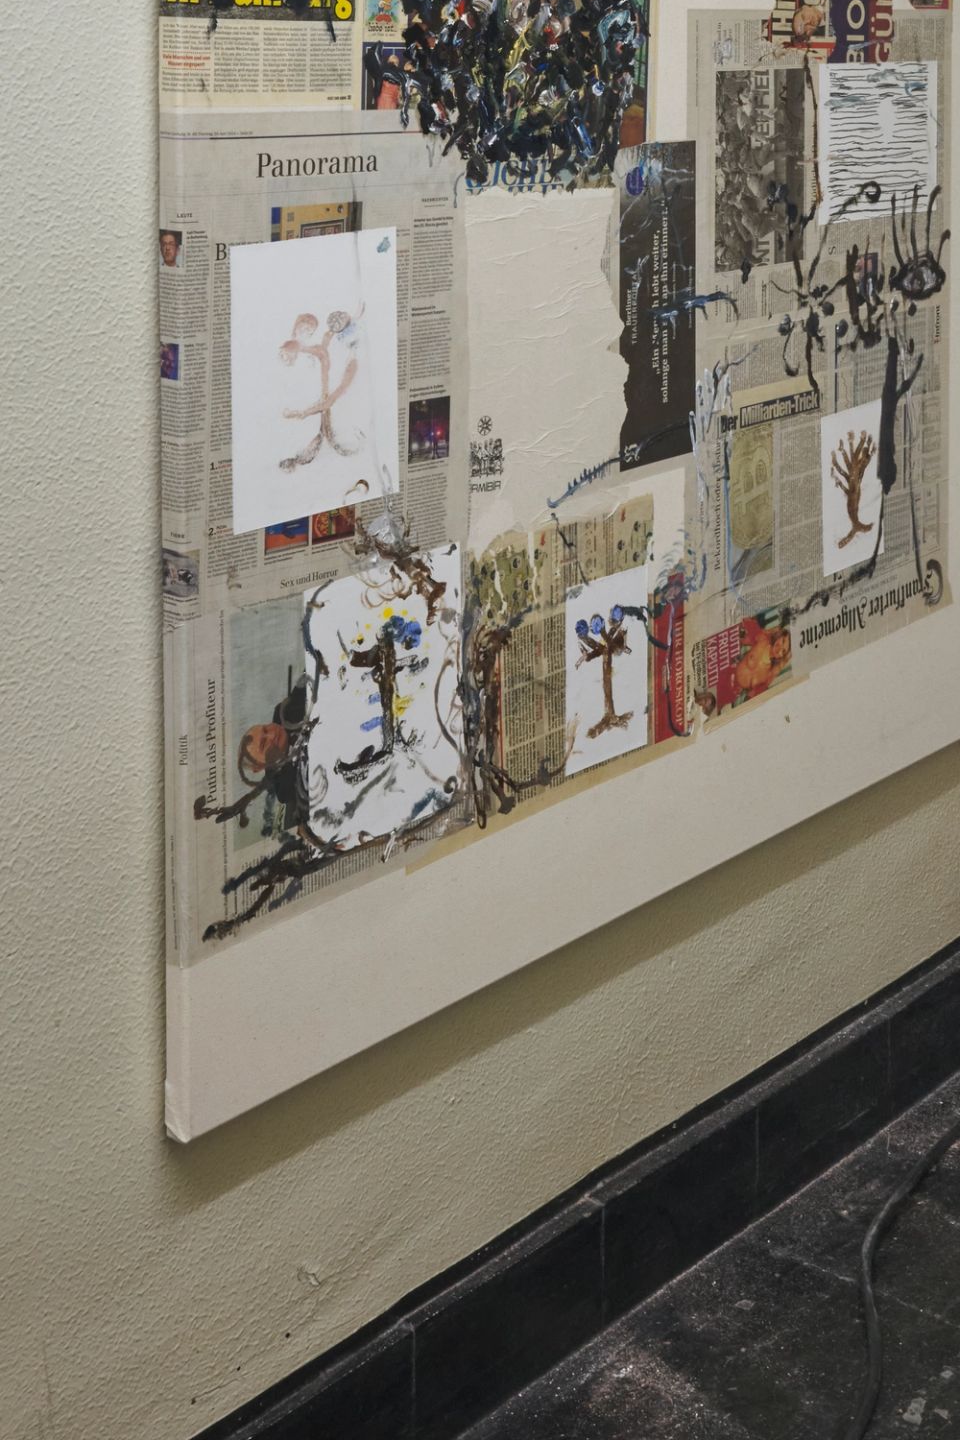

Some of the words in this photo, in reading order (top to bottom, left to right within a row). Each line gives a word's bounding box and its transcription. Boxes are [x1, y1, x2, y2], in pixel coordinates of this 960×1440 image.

[256, 152, 379, 179] Panorama
[651, 229, 661, 272] weiter,
[651, 274, 660, 297] lebt
[662, 330, 670, 355] man
[661, 359, 671, 404] solange
[721, 415, 738, 433] Der
[741, 391, 819, 427] Milliarden-Trick
[280, 579, 294, 589] Sex
[295, 573, 311, 585] und
[312, 568, 339, 581] Horror
[675, 621, 683, 647] IHR
[729, 625, 740, 658] TUTTI
[800, 596, 867, 649] Allgemeine
[707, 637, 719, 689] KAPUTTI
[718, 631, 730, 671] FRUTTI
[675, 650, 683, 726] HOROSKOP
[205, 679, 217, 743] Profiteur
[179, 735, 188, 766] Politik
[206, 744, 217, 765] als
[207, 767, 218, 805] Putin
